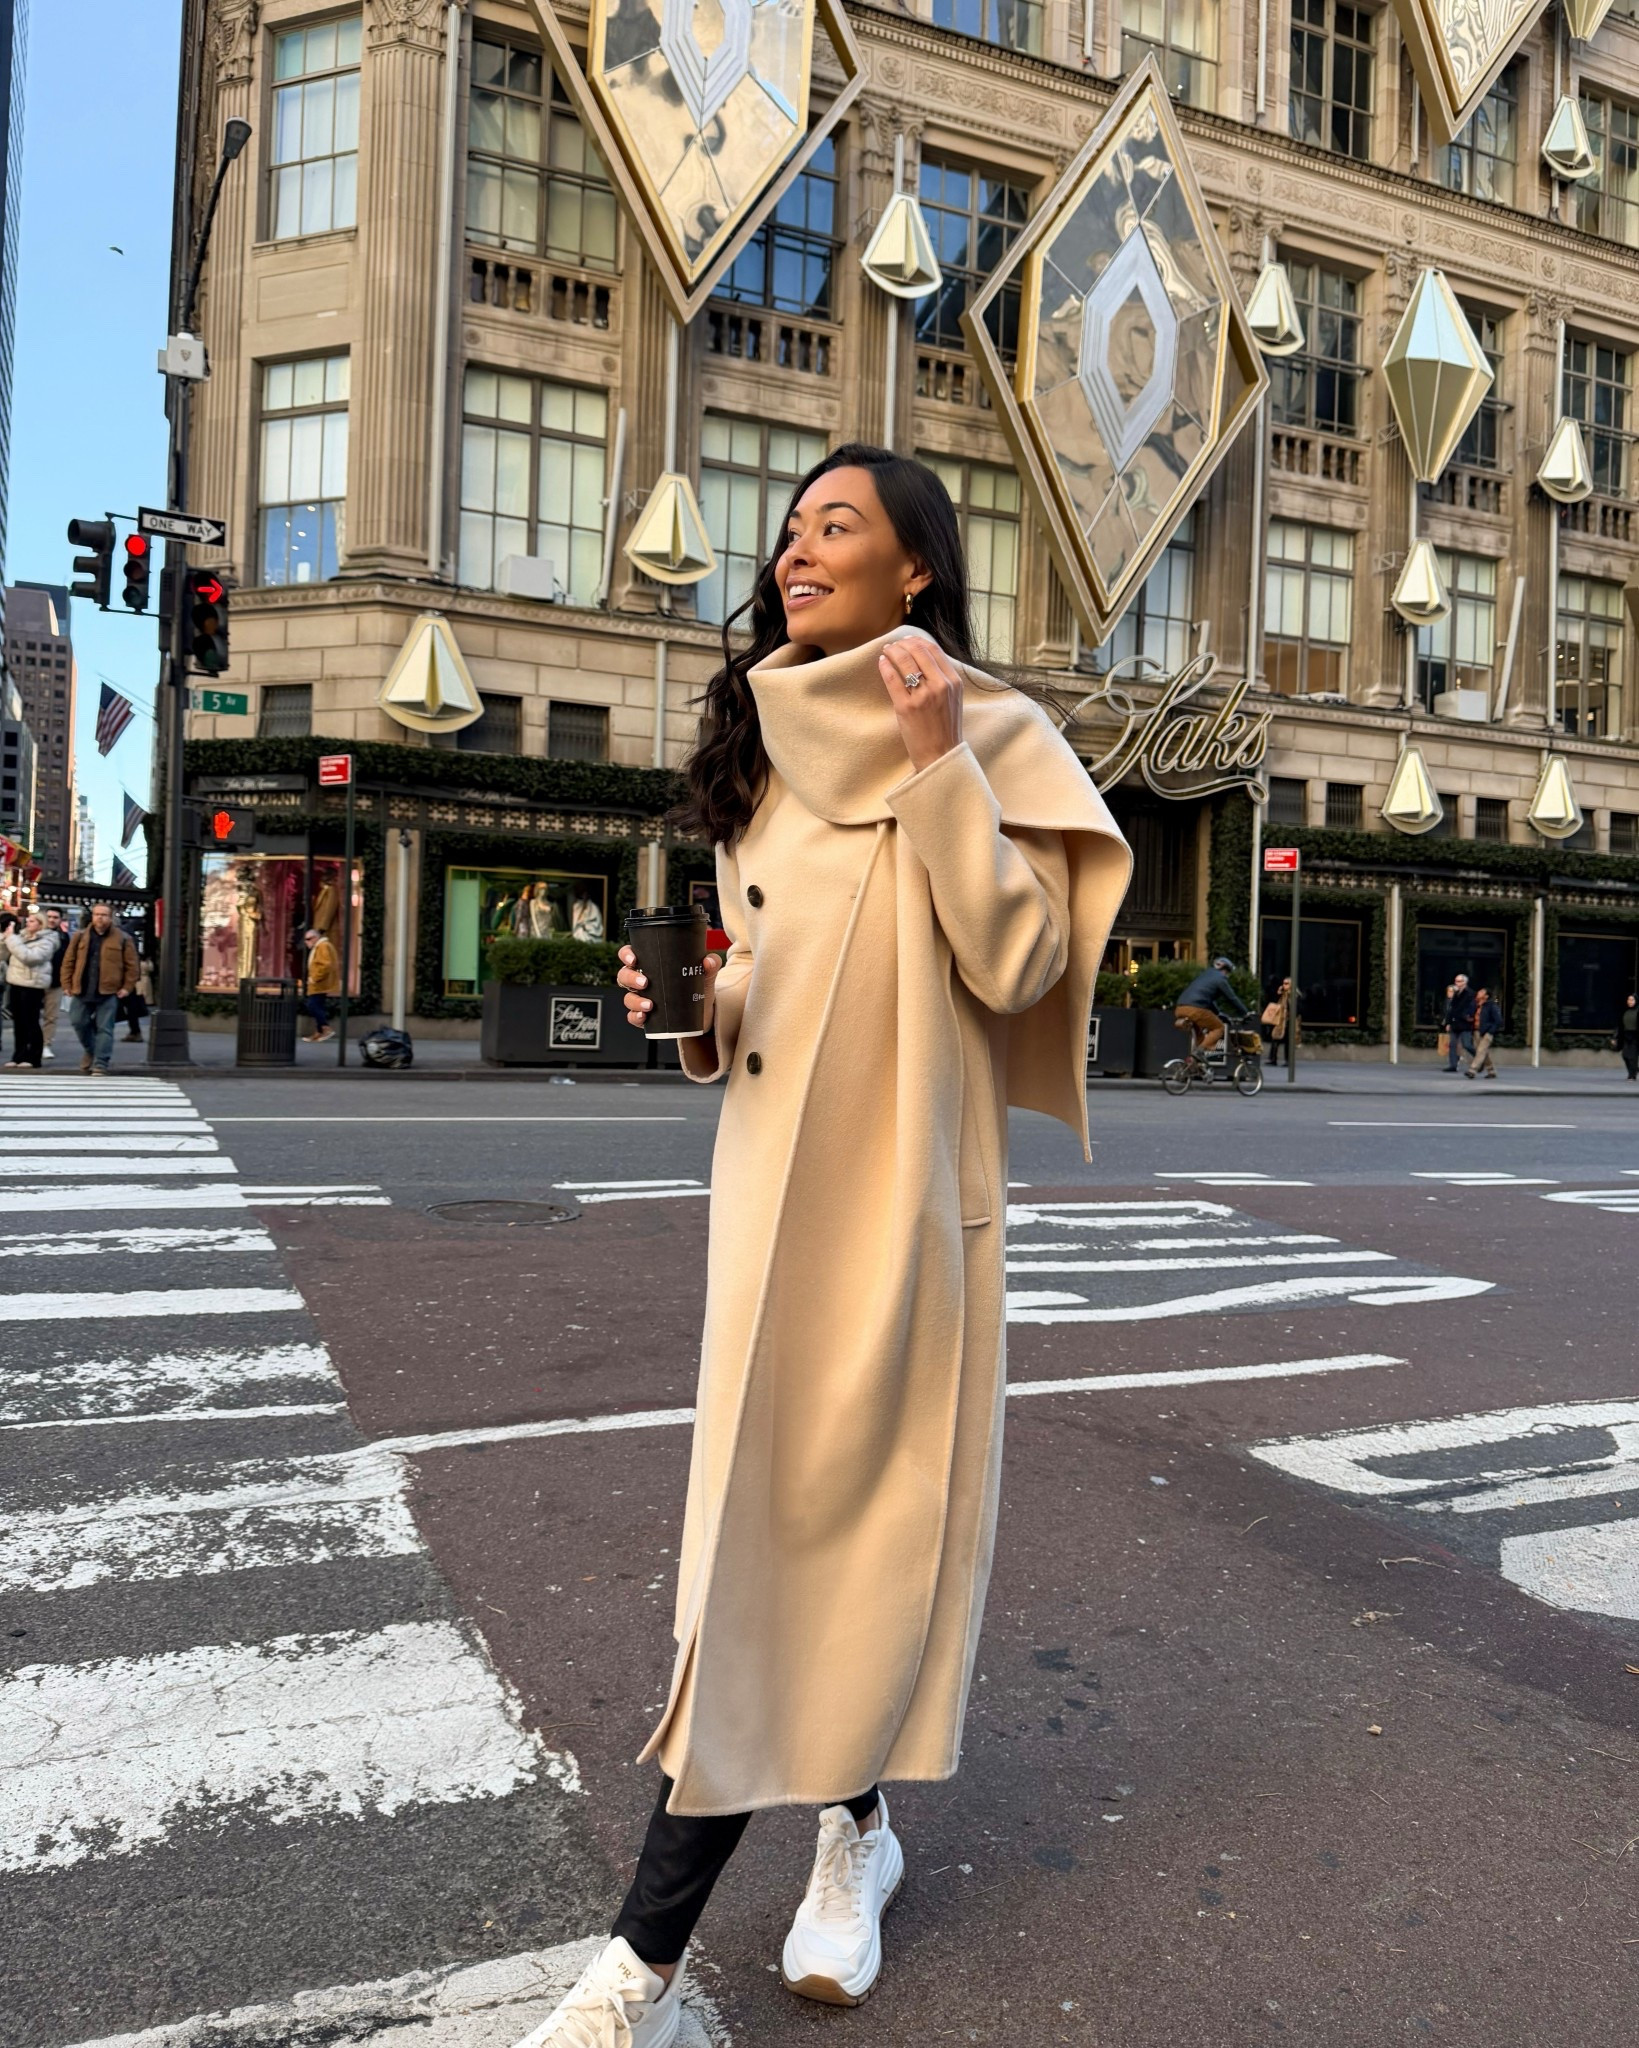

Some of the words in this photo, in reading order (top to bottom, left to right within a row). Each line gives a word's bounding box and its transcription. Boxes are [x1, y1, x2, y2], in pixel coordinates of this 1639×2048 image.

[149, 517, 175, 532] ONE
[187, 523, 213, 537] WAY
[212, 693, 221, 710] 5
[1059, 652, 1274, 804] Saks
